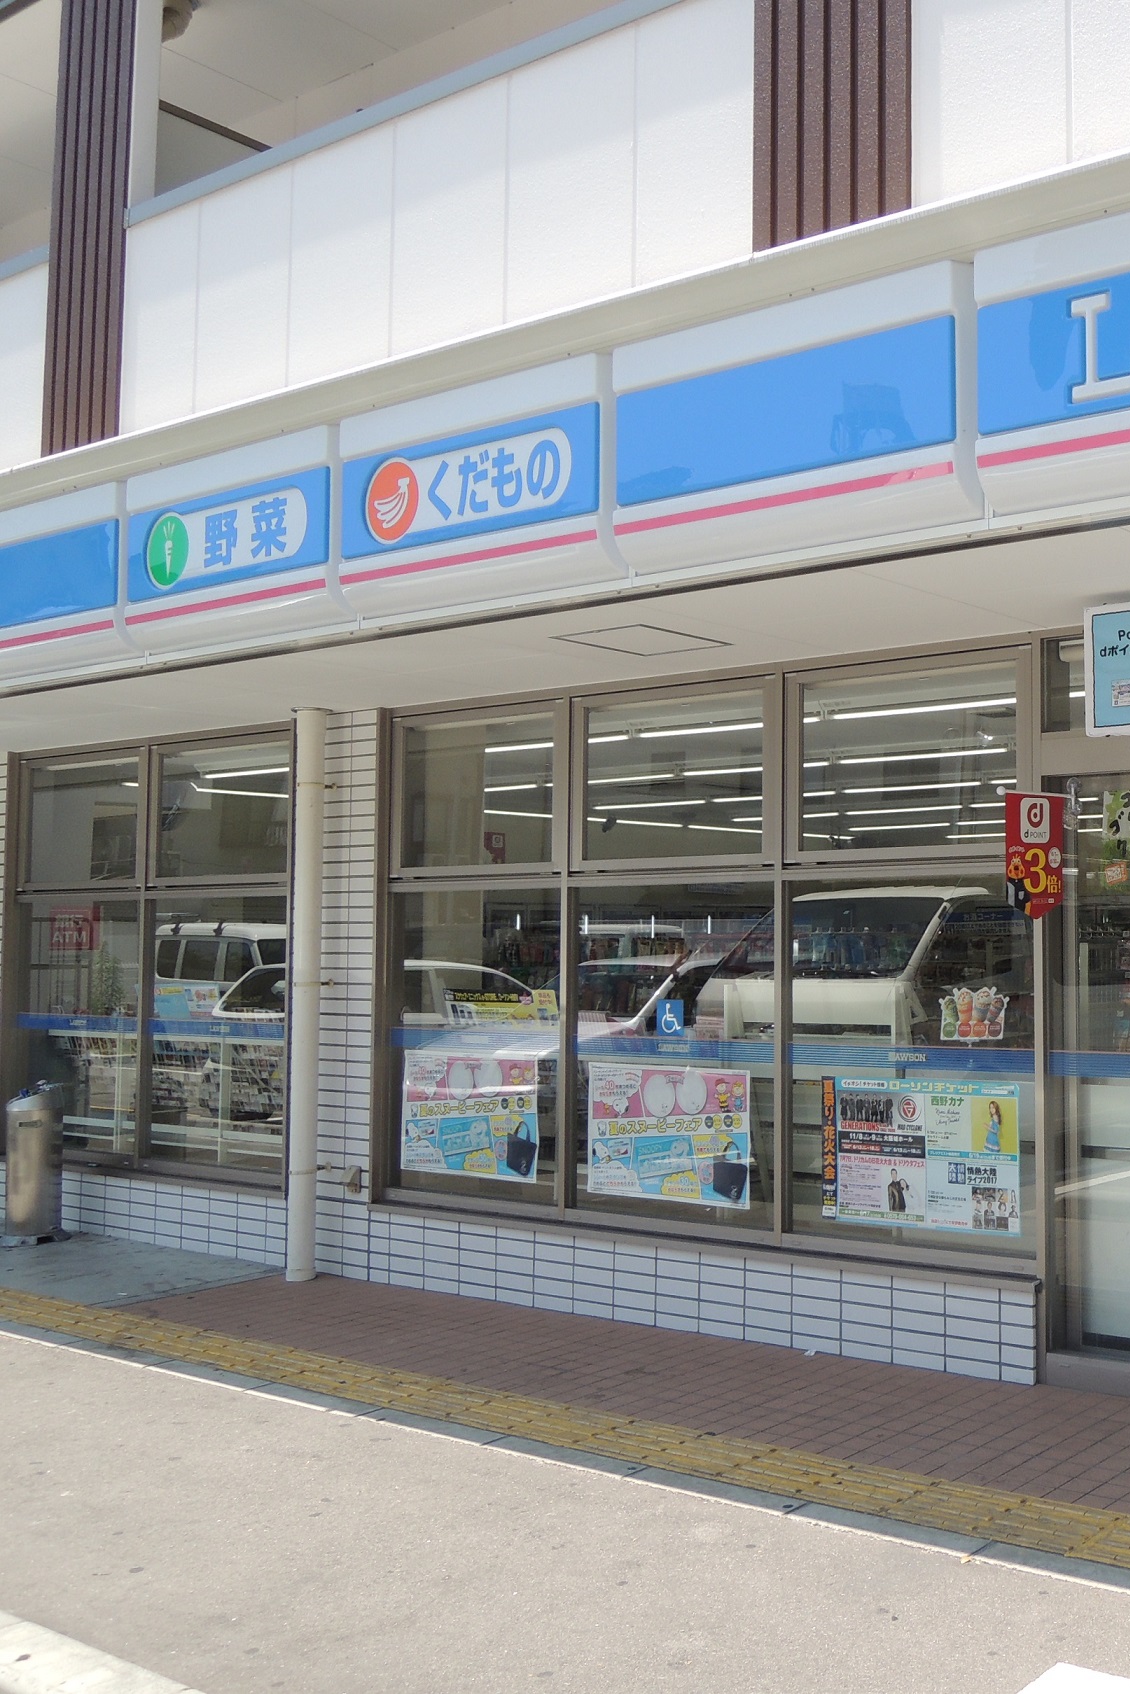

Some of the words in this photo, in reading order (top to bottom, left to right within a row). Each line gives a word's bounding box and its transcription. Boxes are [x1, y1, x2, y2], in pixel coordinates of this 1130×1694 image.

[426, 438, 561, 522] くだもの
[202, 495, 288, 569] 野菜
[52, 930, 87, 944] ATM
[888, 1080, 979, 1094] ローソンチケット
[419, 1100, 500, 1118] 夏のスヌーピーフェア
[930, 1095, 965, 1107] 西野カナ
[608, 1118, 703, 1136] 夏のスヌーピーフェア
[822, 1079, 836, 1180] 夏祭り・花火大会
[840, 1121, 880, 1131] GENERATIONS
[967, 1166, 997, 1176] 情熱大陸
